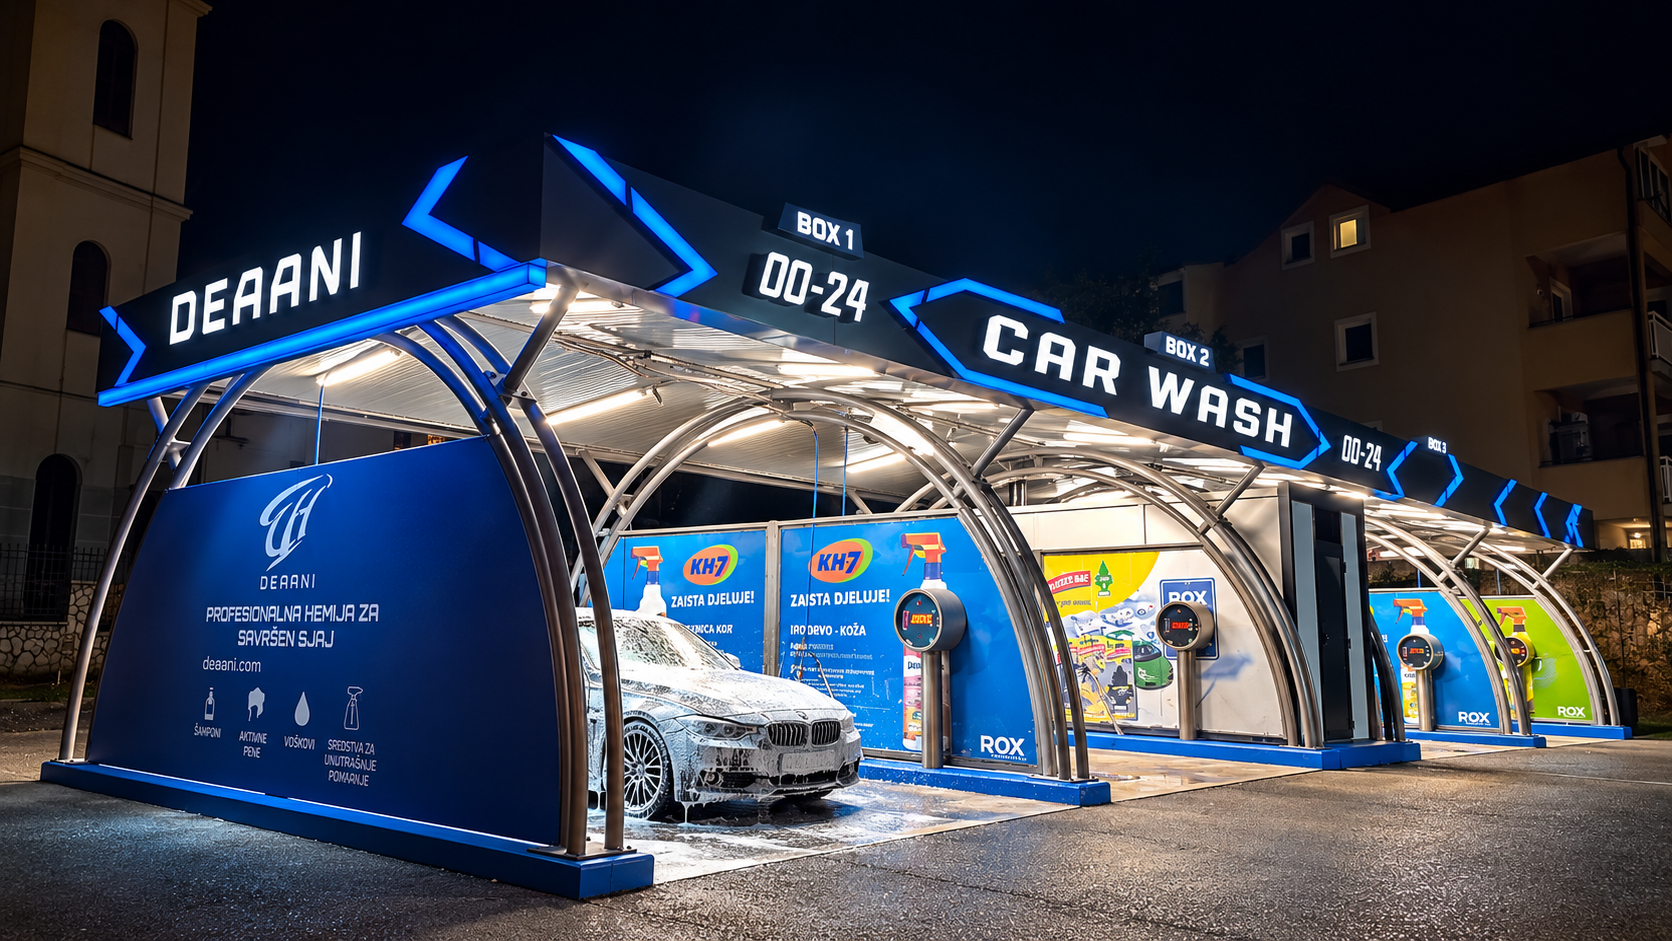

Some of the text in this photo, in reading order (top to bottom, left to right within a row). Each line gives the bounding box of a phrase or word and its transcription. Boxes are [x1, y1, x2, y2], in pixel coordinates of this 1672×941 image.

[797, 211, 854, 250] BOX 1
[169, 231, 361, 345] DEAANI
[759, 251, 869, 322] 00-24
[1165, 335, 1210, 367] BOX 2
[982, 314, 1293, 448] CAR WASH
[1341, 434, 1382, 472] 00-24
[1428, 436, 1447, 454] BOX 3
[260, 573, 316, 590] DEAANI
[671, 590, 755, 608] ZAISTA DJELUJE!
[790, 588, 890, 608] ZAISTA DJELUJE!
[205, 603, 379, 623] PROFESIONALNA HEMIJA ZA
[237, 625, 335, 648] SAVRŠEN SJAJ
[840, 622, 867, 637] KOŽA
[202, 655, 262, 672] deaani.com
[1457, 711, 1490, 724] ROX
[1557, 706, 1586, 718] ROX
[283, 734, 316, 750] VOŠKOVI
[364, 742, 376, 756] ZA
[980, 734, 1025, 757] ROX
